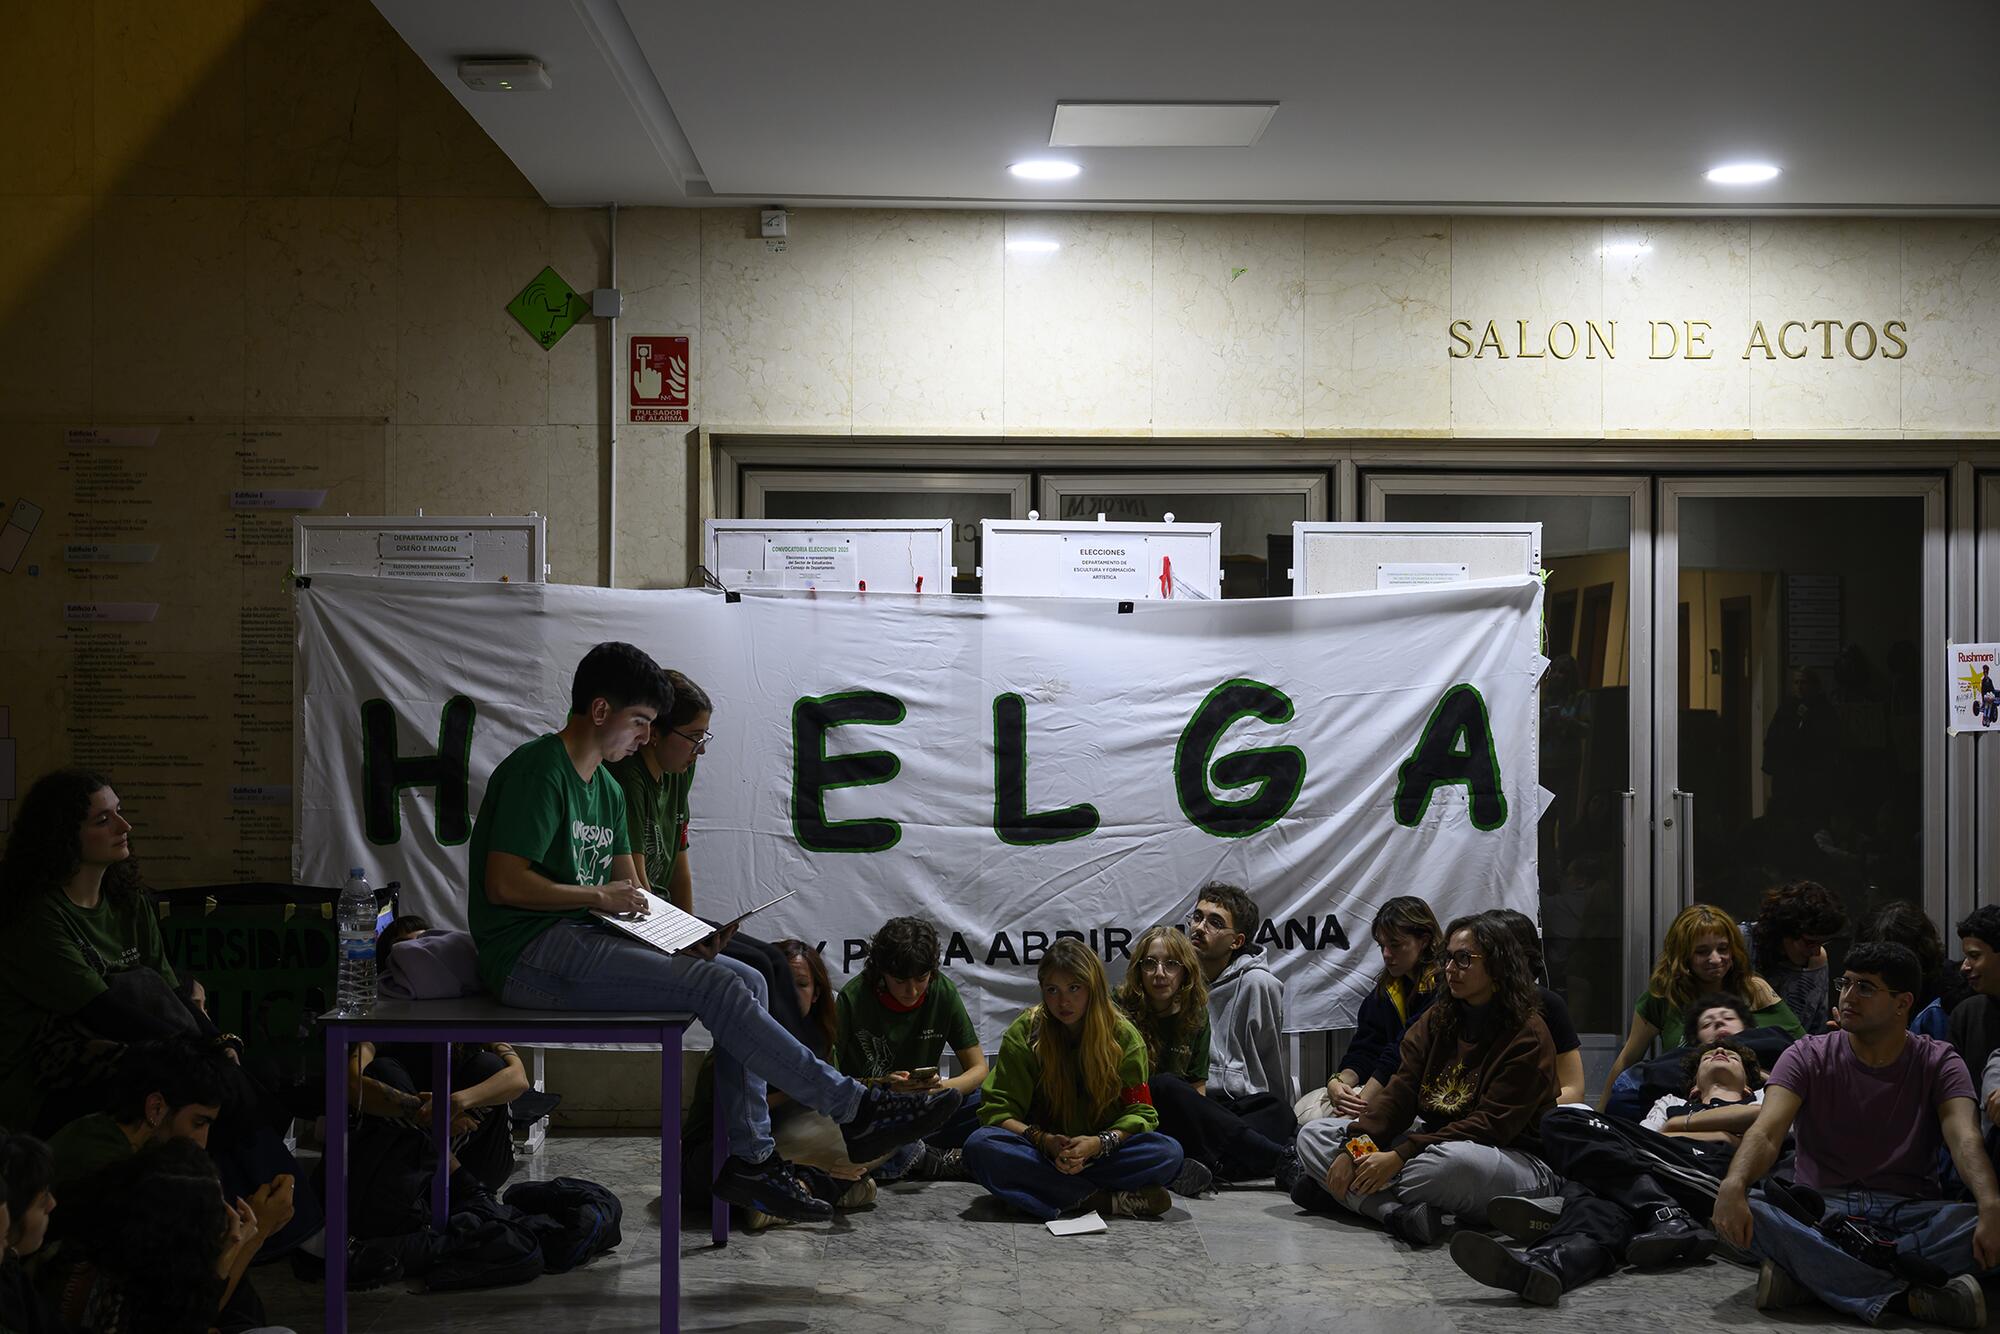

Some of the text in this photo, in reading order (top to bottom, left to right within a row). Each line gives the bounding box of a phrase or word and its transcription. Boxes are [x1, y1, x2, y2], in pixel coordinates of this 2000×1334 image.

[1448, 319, 1908, 360] SALON DE ACTOS
[1958, 653, 1994, 663] Rushmore
[361, 679, 1508, 853] HELGA
[843, 932, 975, 973] PA
[1529, 1220, 1551, 1231] OBE
